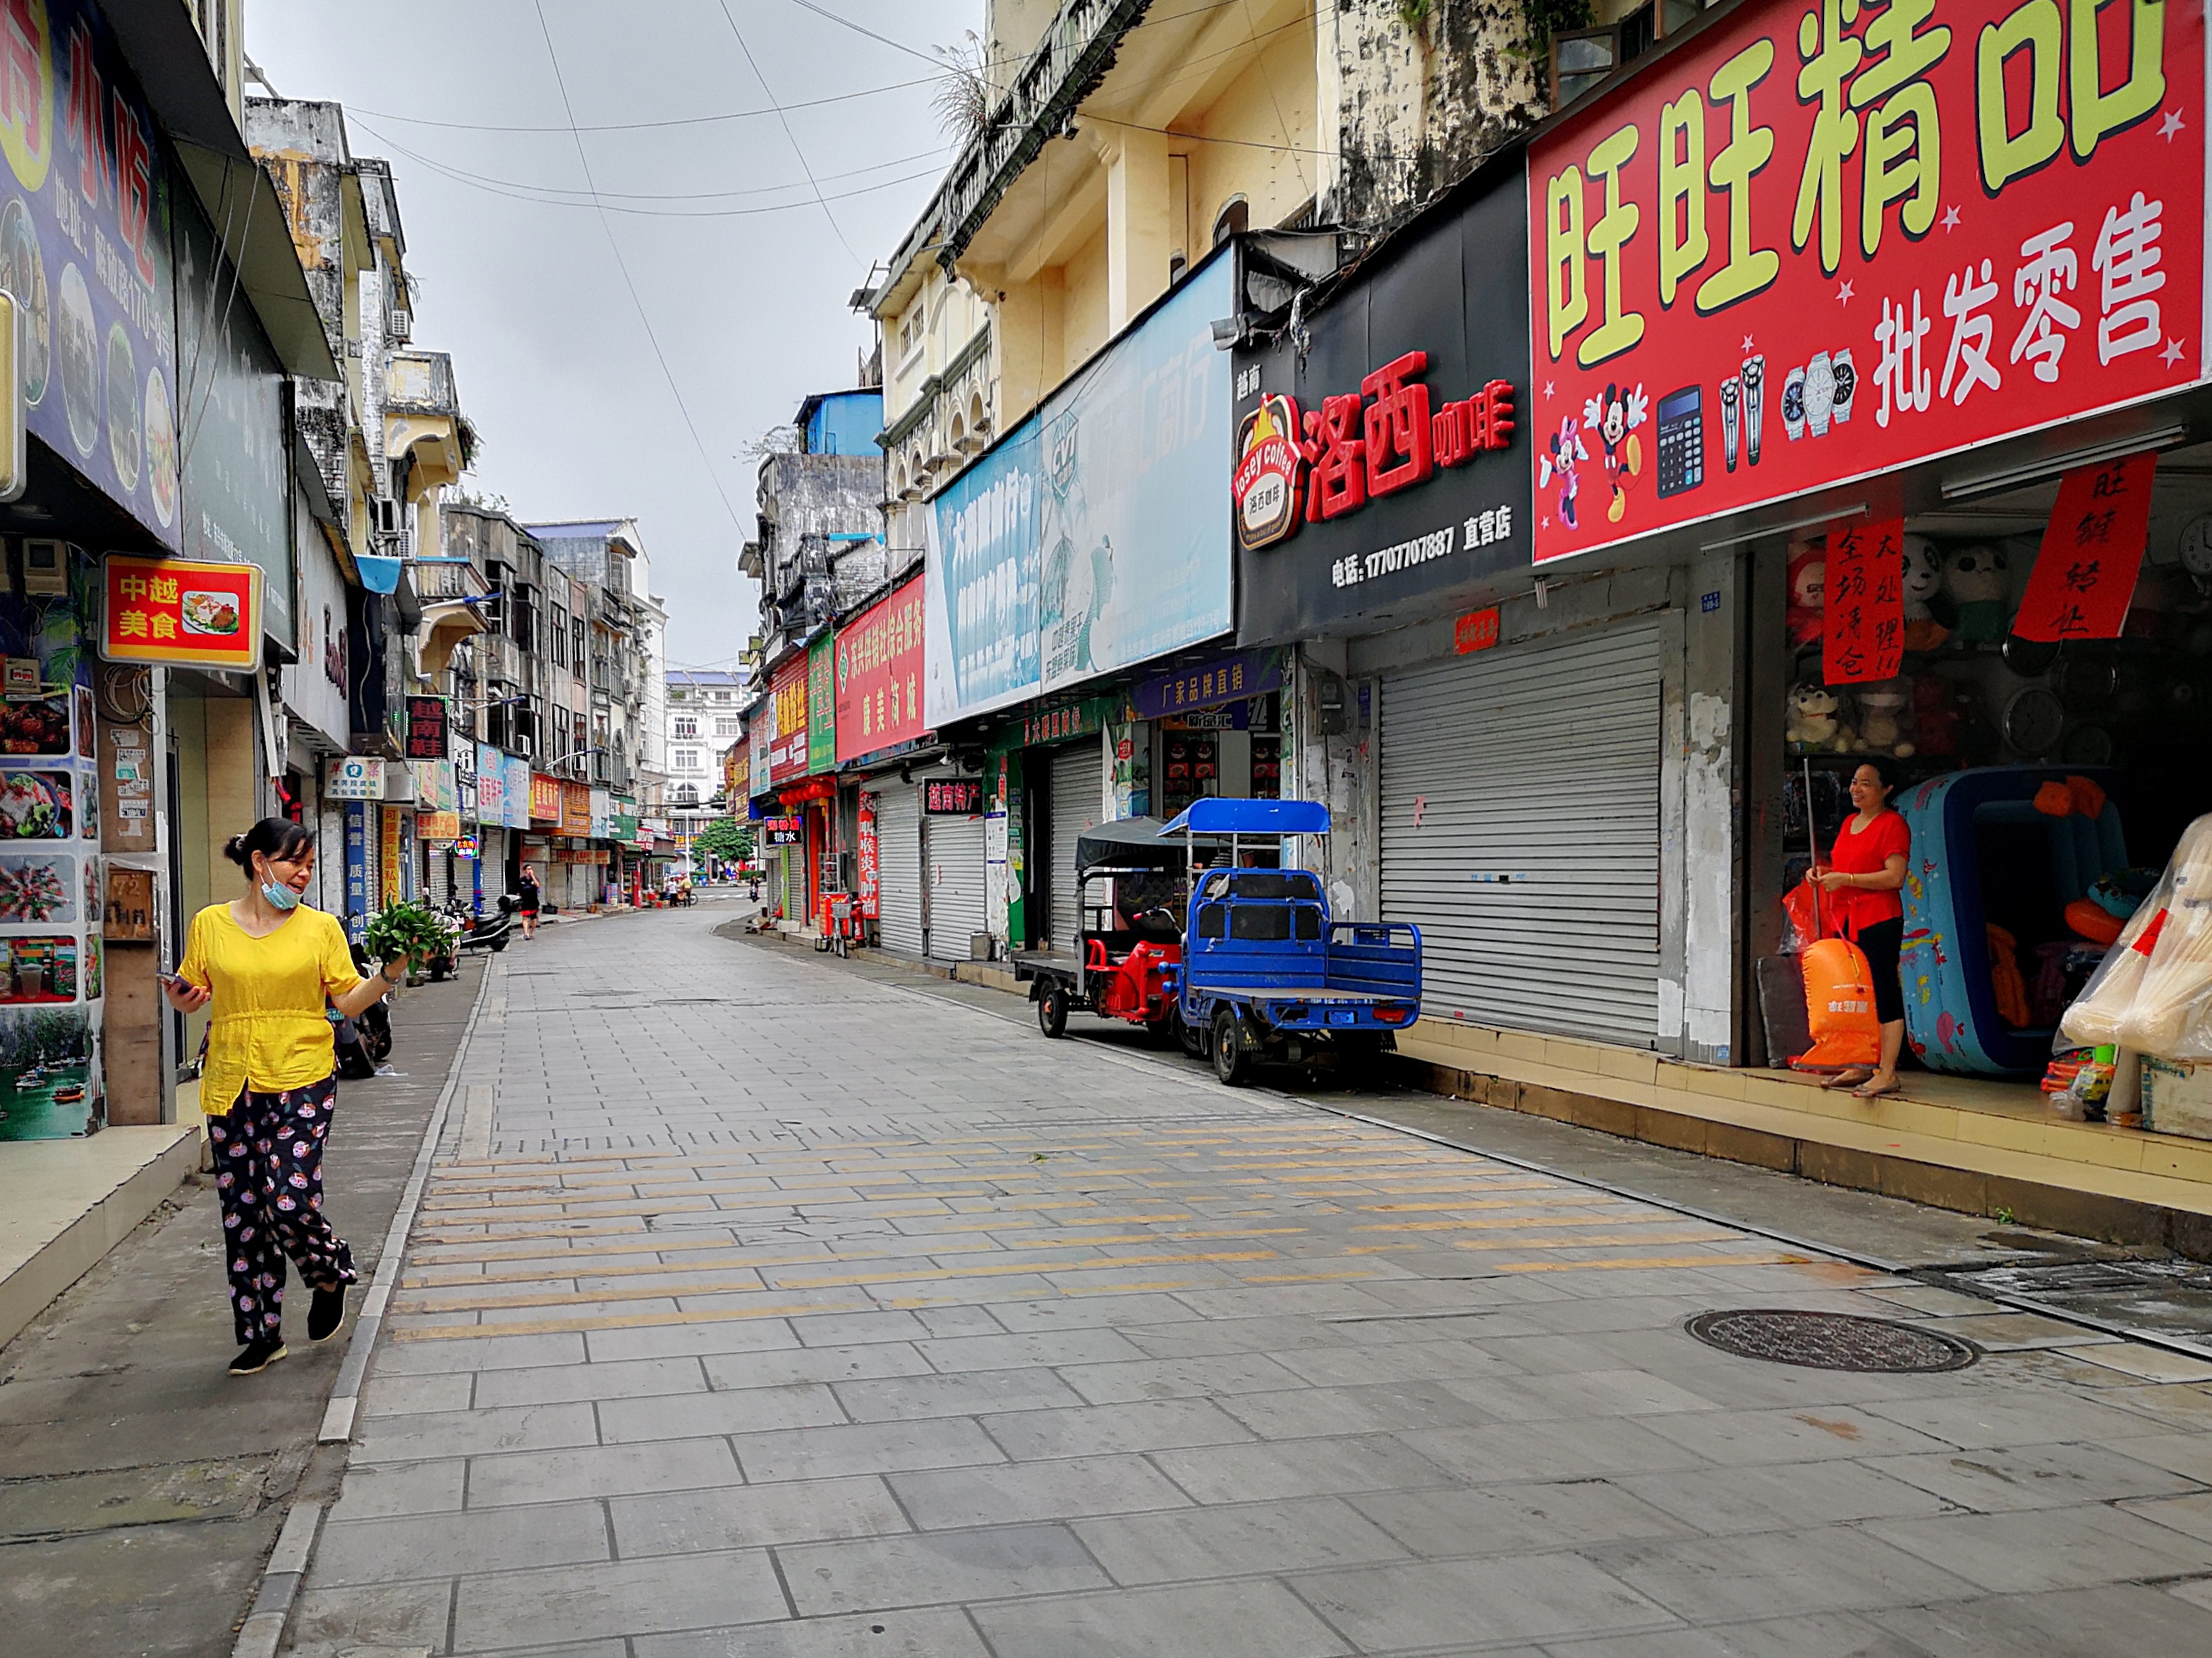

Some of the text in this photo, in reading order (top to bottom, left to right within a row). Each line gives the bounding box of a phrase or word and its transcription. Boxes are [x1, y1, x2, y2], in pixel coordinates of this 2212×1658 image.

[66, 12, 155, 293] 小吃
[1545, 0, 2166, 370] 旺旺精品
[1874, 190, 2166, 430] 批发零售
[1236, 364, 1261, 401] 越南
[1052, 421, 1078, 476] CVT
[1303, 350, 1516, 524] 洛西咖啡
[1235, 441, 1292, 498] losey coffee
[1249, 483, 1280, 515] 洛西咖啡
[1462, 504, 1513, 551] 直营店
[119, 574, 178, 605] 中越
[1834, 528, 1868, 677] 全场清仓
[119, 609, 178, 640] 美食
[850, 597, 925, 680] 东兴供销社综合服务
[1162, 663, 1243, 708] 厂家品牌直销
[1186, 713, 1233, 729] 新品汇
[928, 782, 980, 811] 越南特产
[348, 813, 363, 846] 信誉
[774, 831, 796, 843] 糖水
[348, 864, 363, 896] 质量
